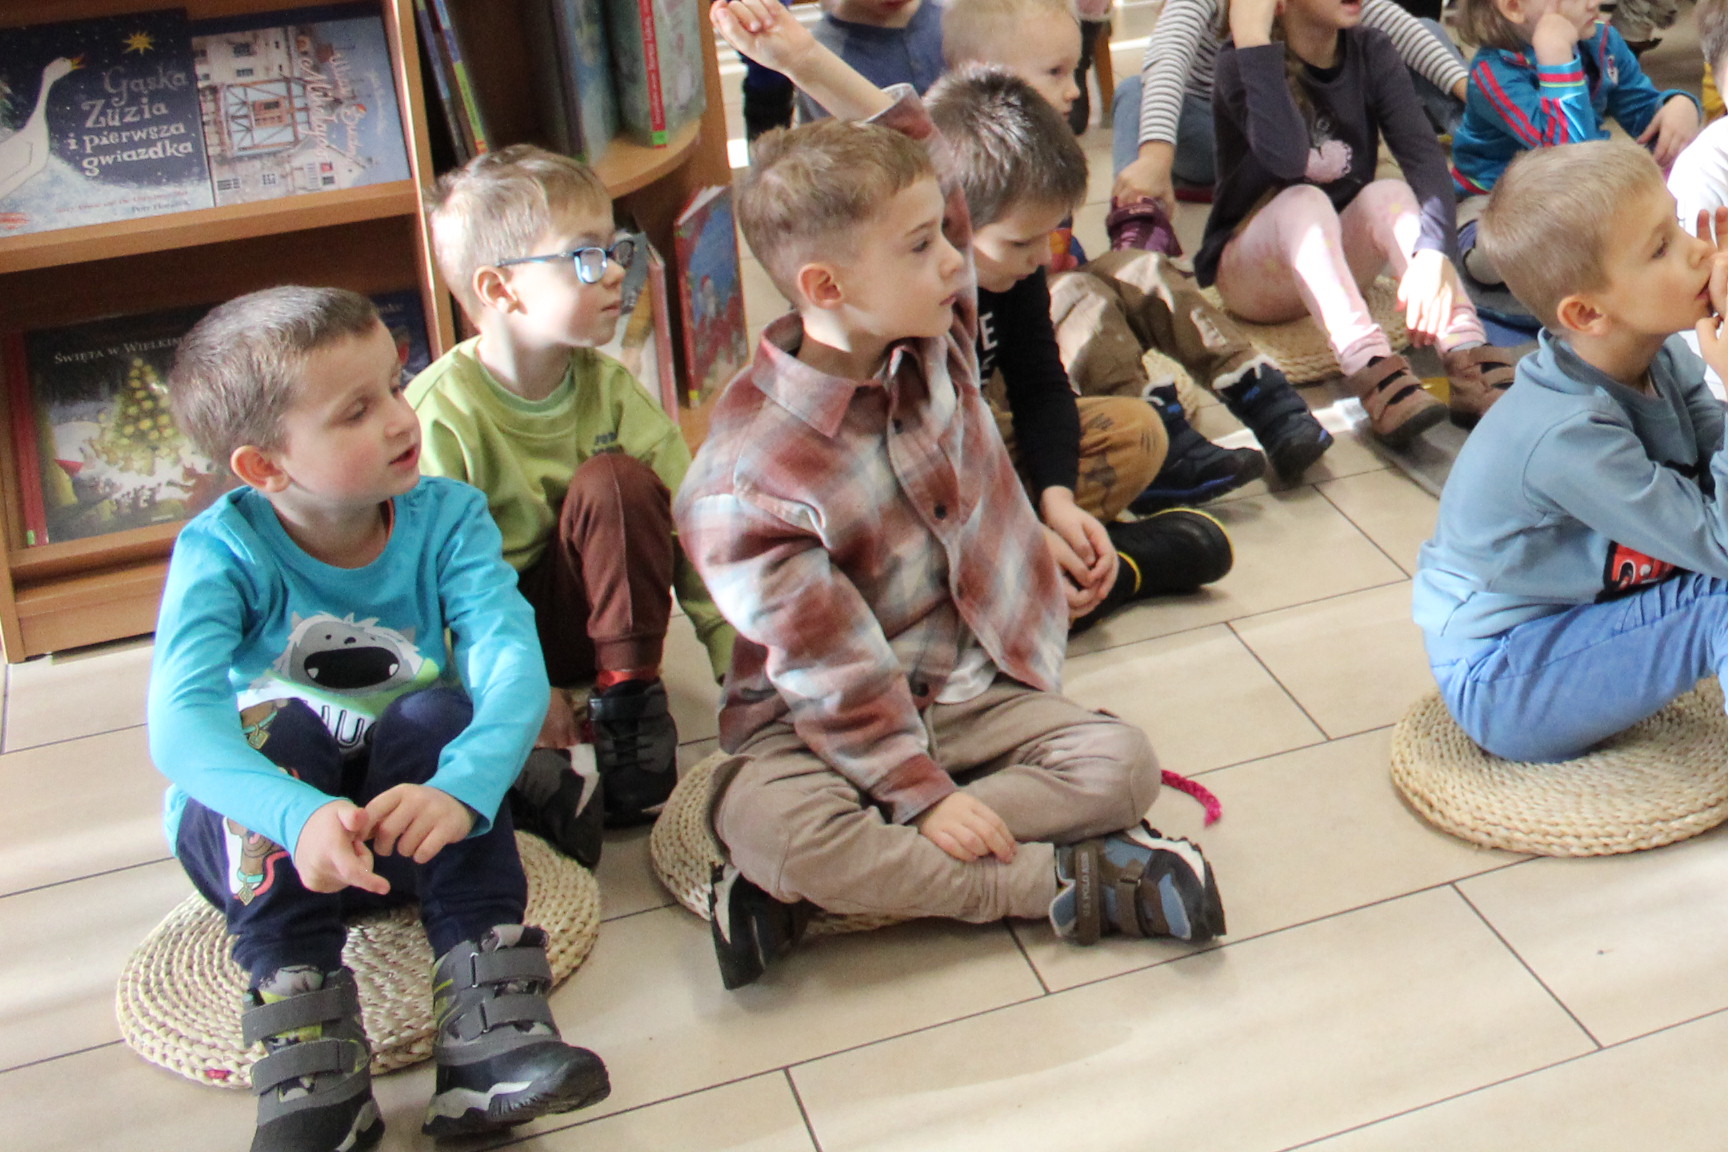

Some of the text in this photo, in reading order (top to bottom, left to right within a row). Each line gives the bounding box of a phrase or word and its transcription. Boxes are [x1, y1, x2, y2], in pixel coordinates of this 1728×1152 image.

[103, 65, 189, 107] Gąska
[80, 96, 168, 128] Zuzia
[67, 121, 186, 154] i pierwsza
[81, 139, 193, 177] gwiazdka
